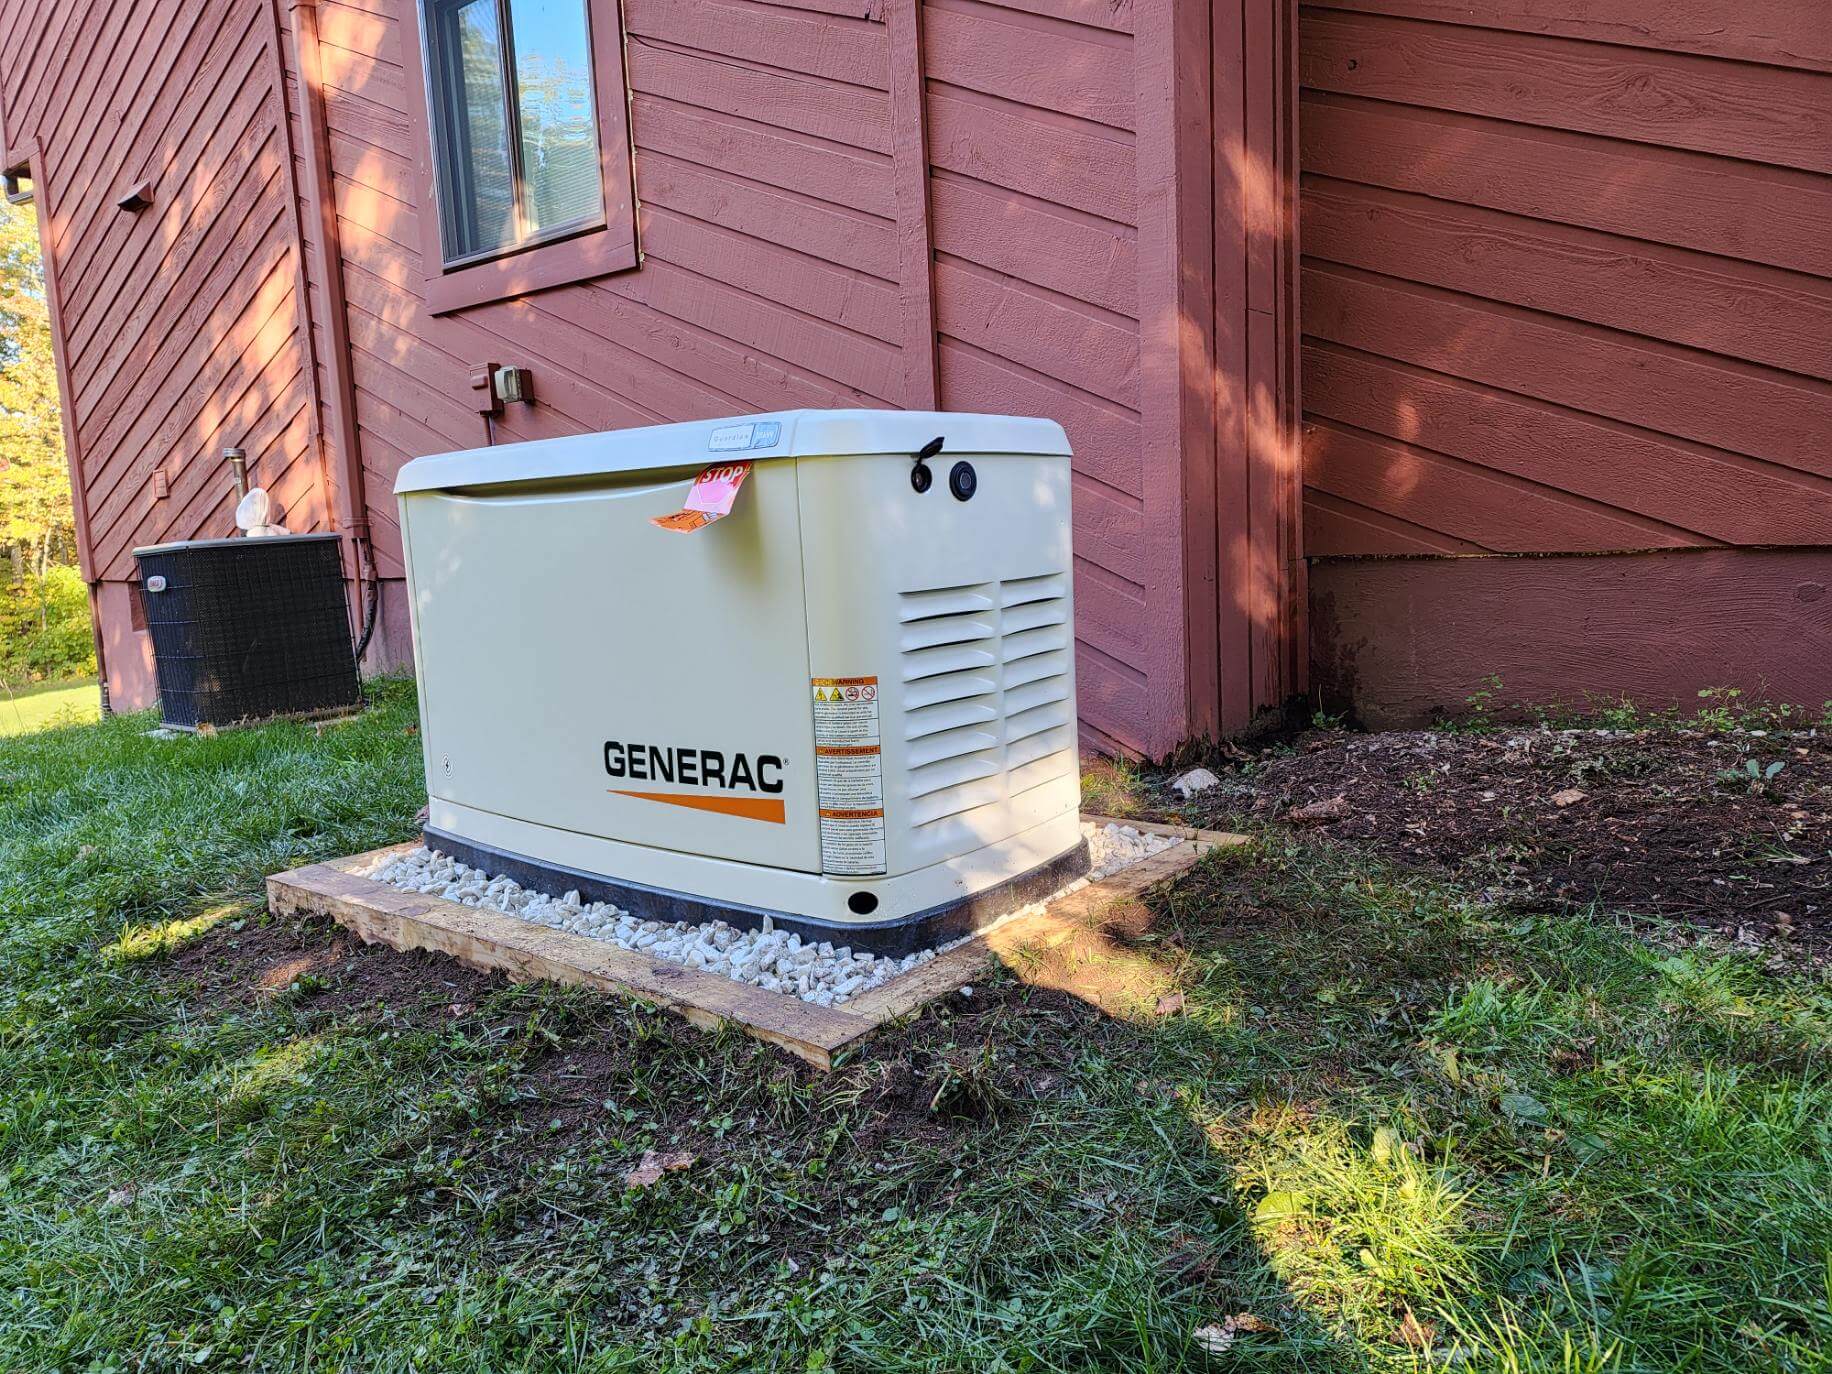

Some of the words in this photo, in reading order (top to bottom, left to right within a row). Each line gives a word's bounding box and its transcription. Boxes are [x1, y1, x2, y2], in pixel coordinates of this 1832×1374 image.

[702, 465, 744, 484] STOP
[833, 678, 865, 686] WARNING
[824, 747, 878, 755] AVERTISSEMENT
[604, 740, 784, 794] GENERAC
[832, 810, 879, 818] ADVERTENCIA
